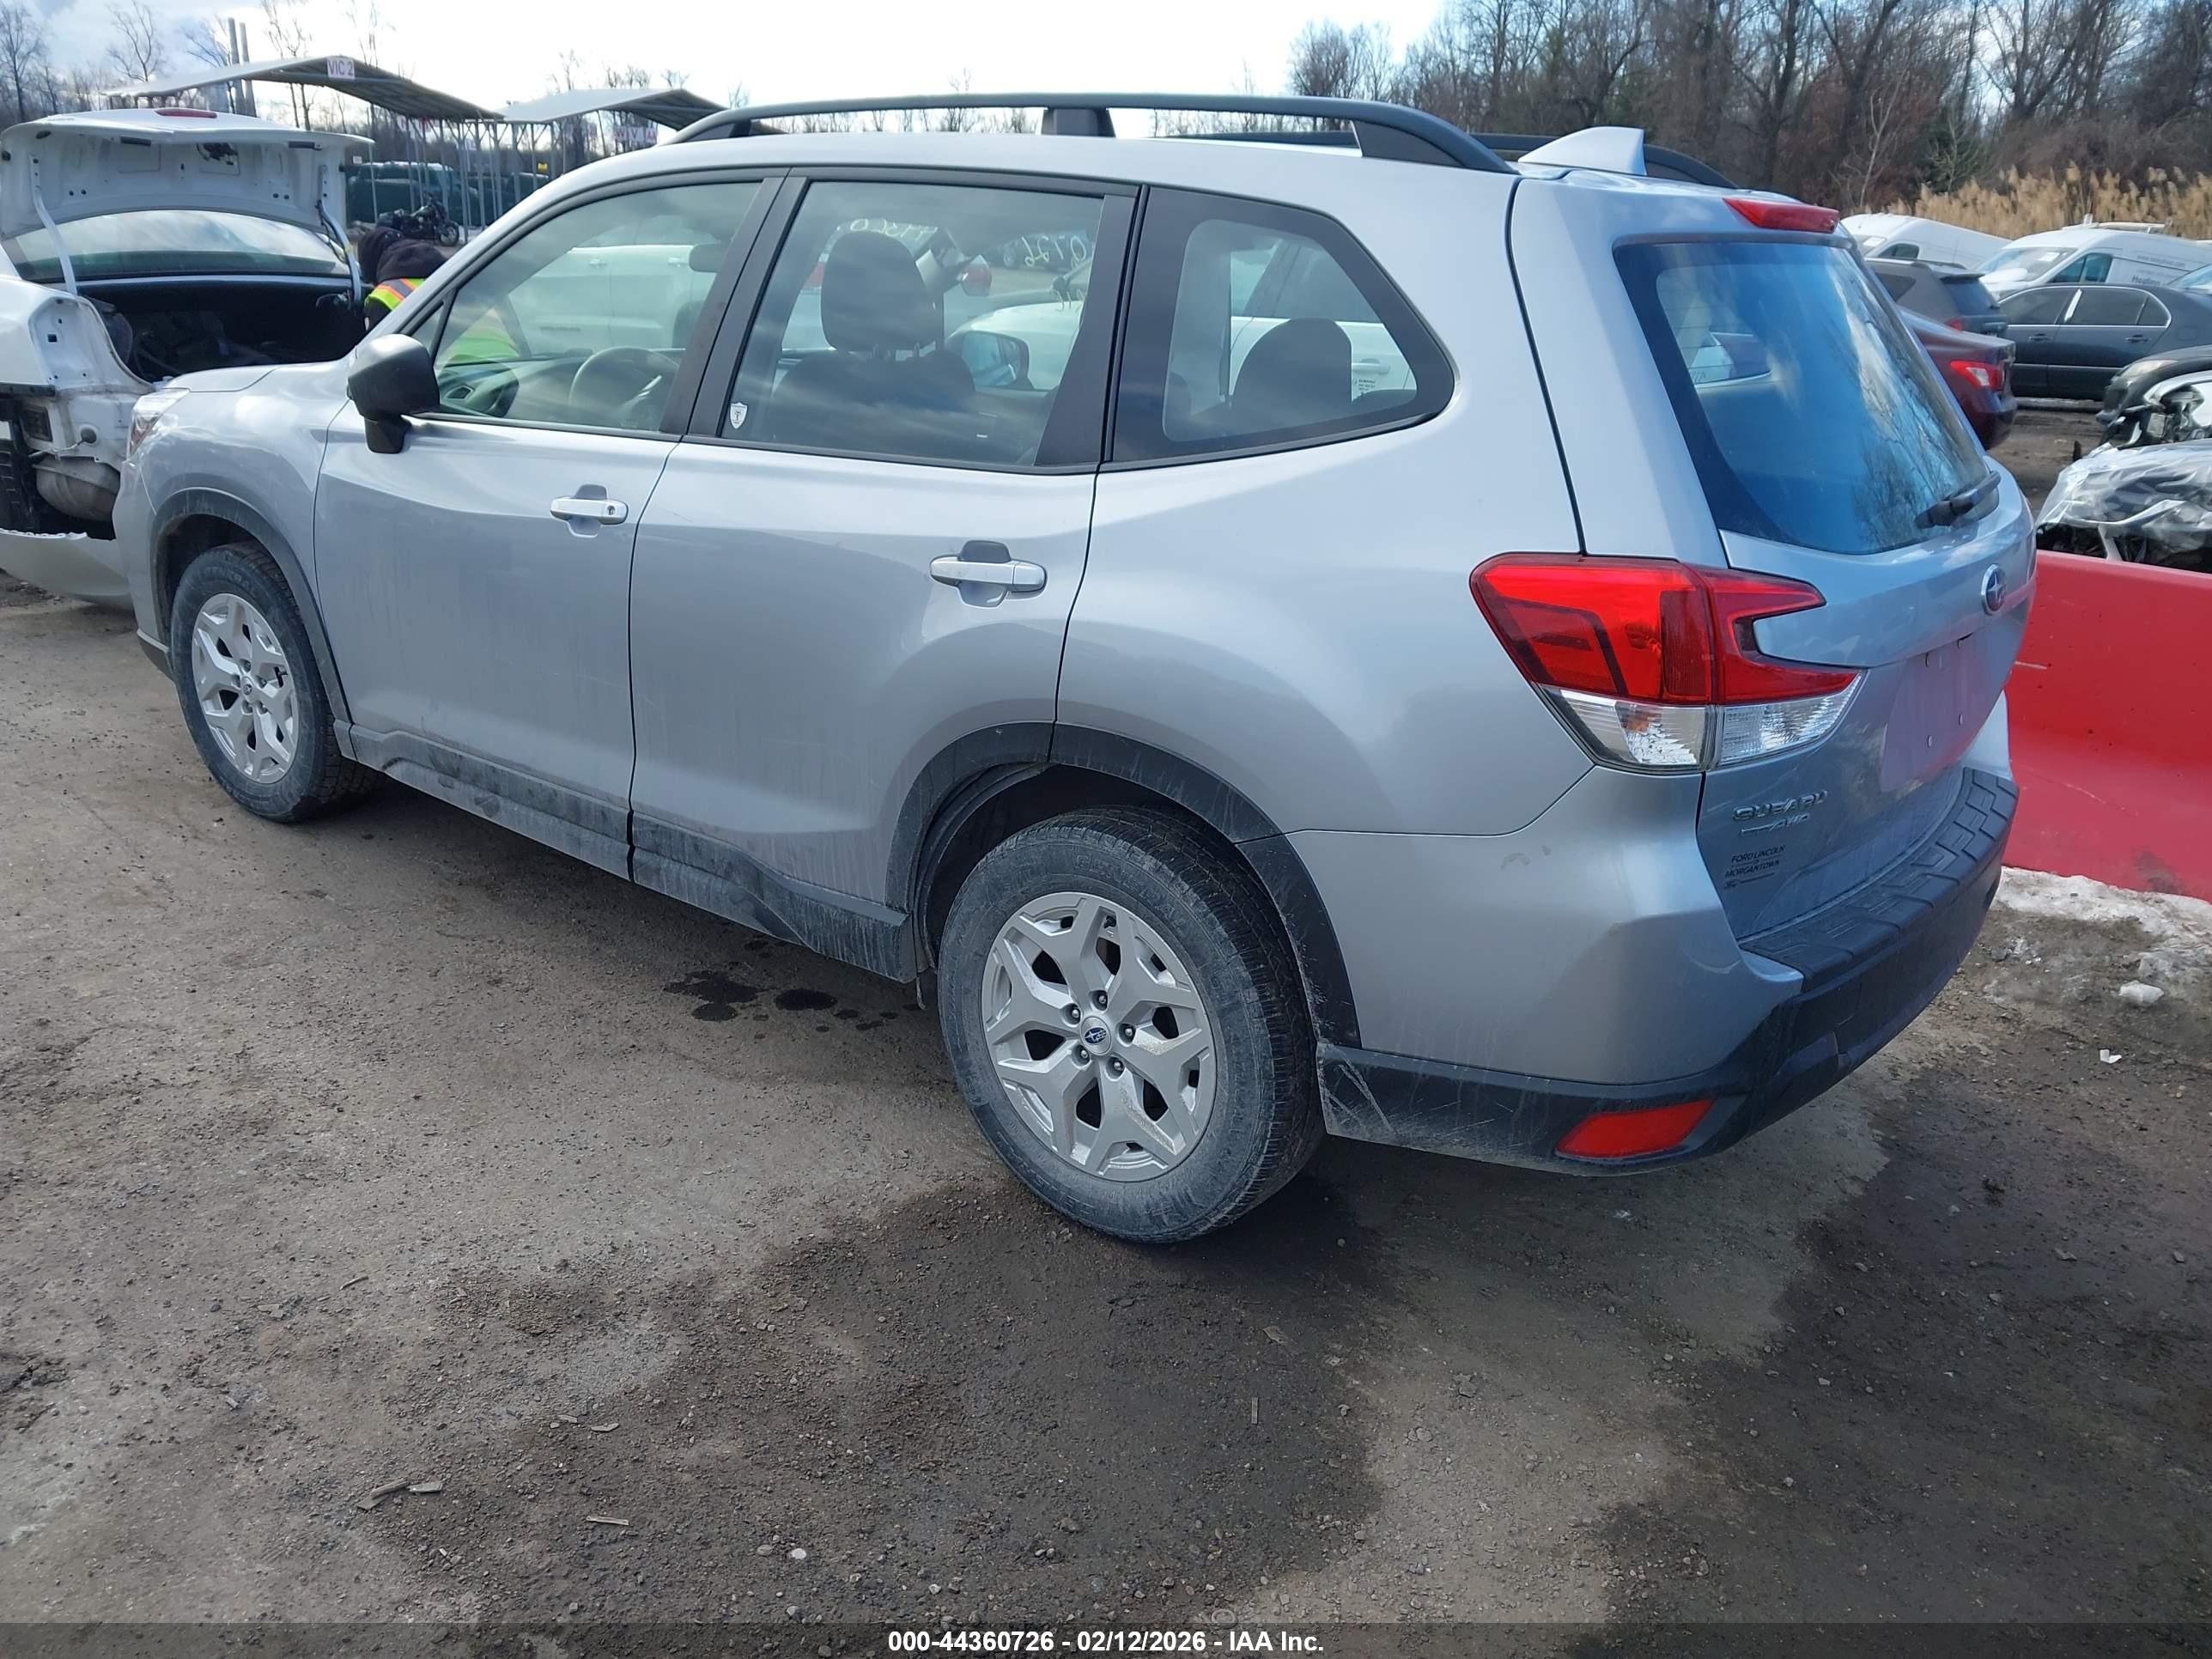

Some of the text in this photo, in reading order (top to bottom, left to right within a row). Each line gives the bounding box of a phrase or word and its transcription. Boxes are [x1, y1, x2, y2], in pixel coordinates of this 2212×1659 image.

[329, 60, 354, 76] VIC 2
[1731, 790, 1828, 821] SUBARU
[1731, 852, 1753, 863] FORD
[1753, 844, 1786, 860] LINCOLN
